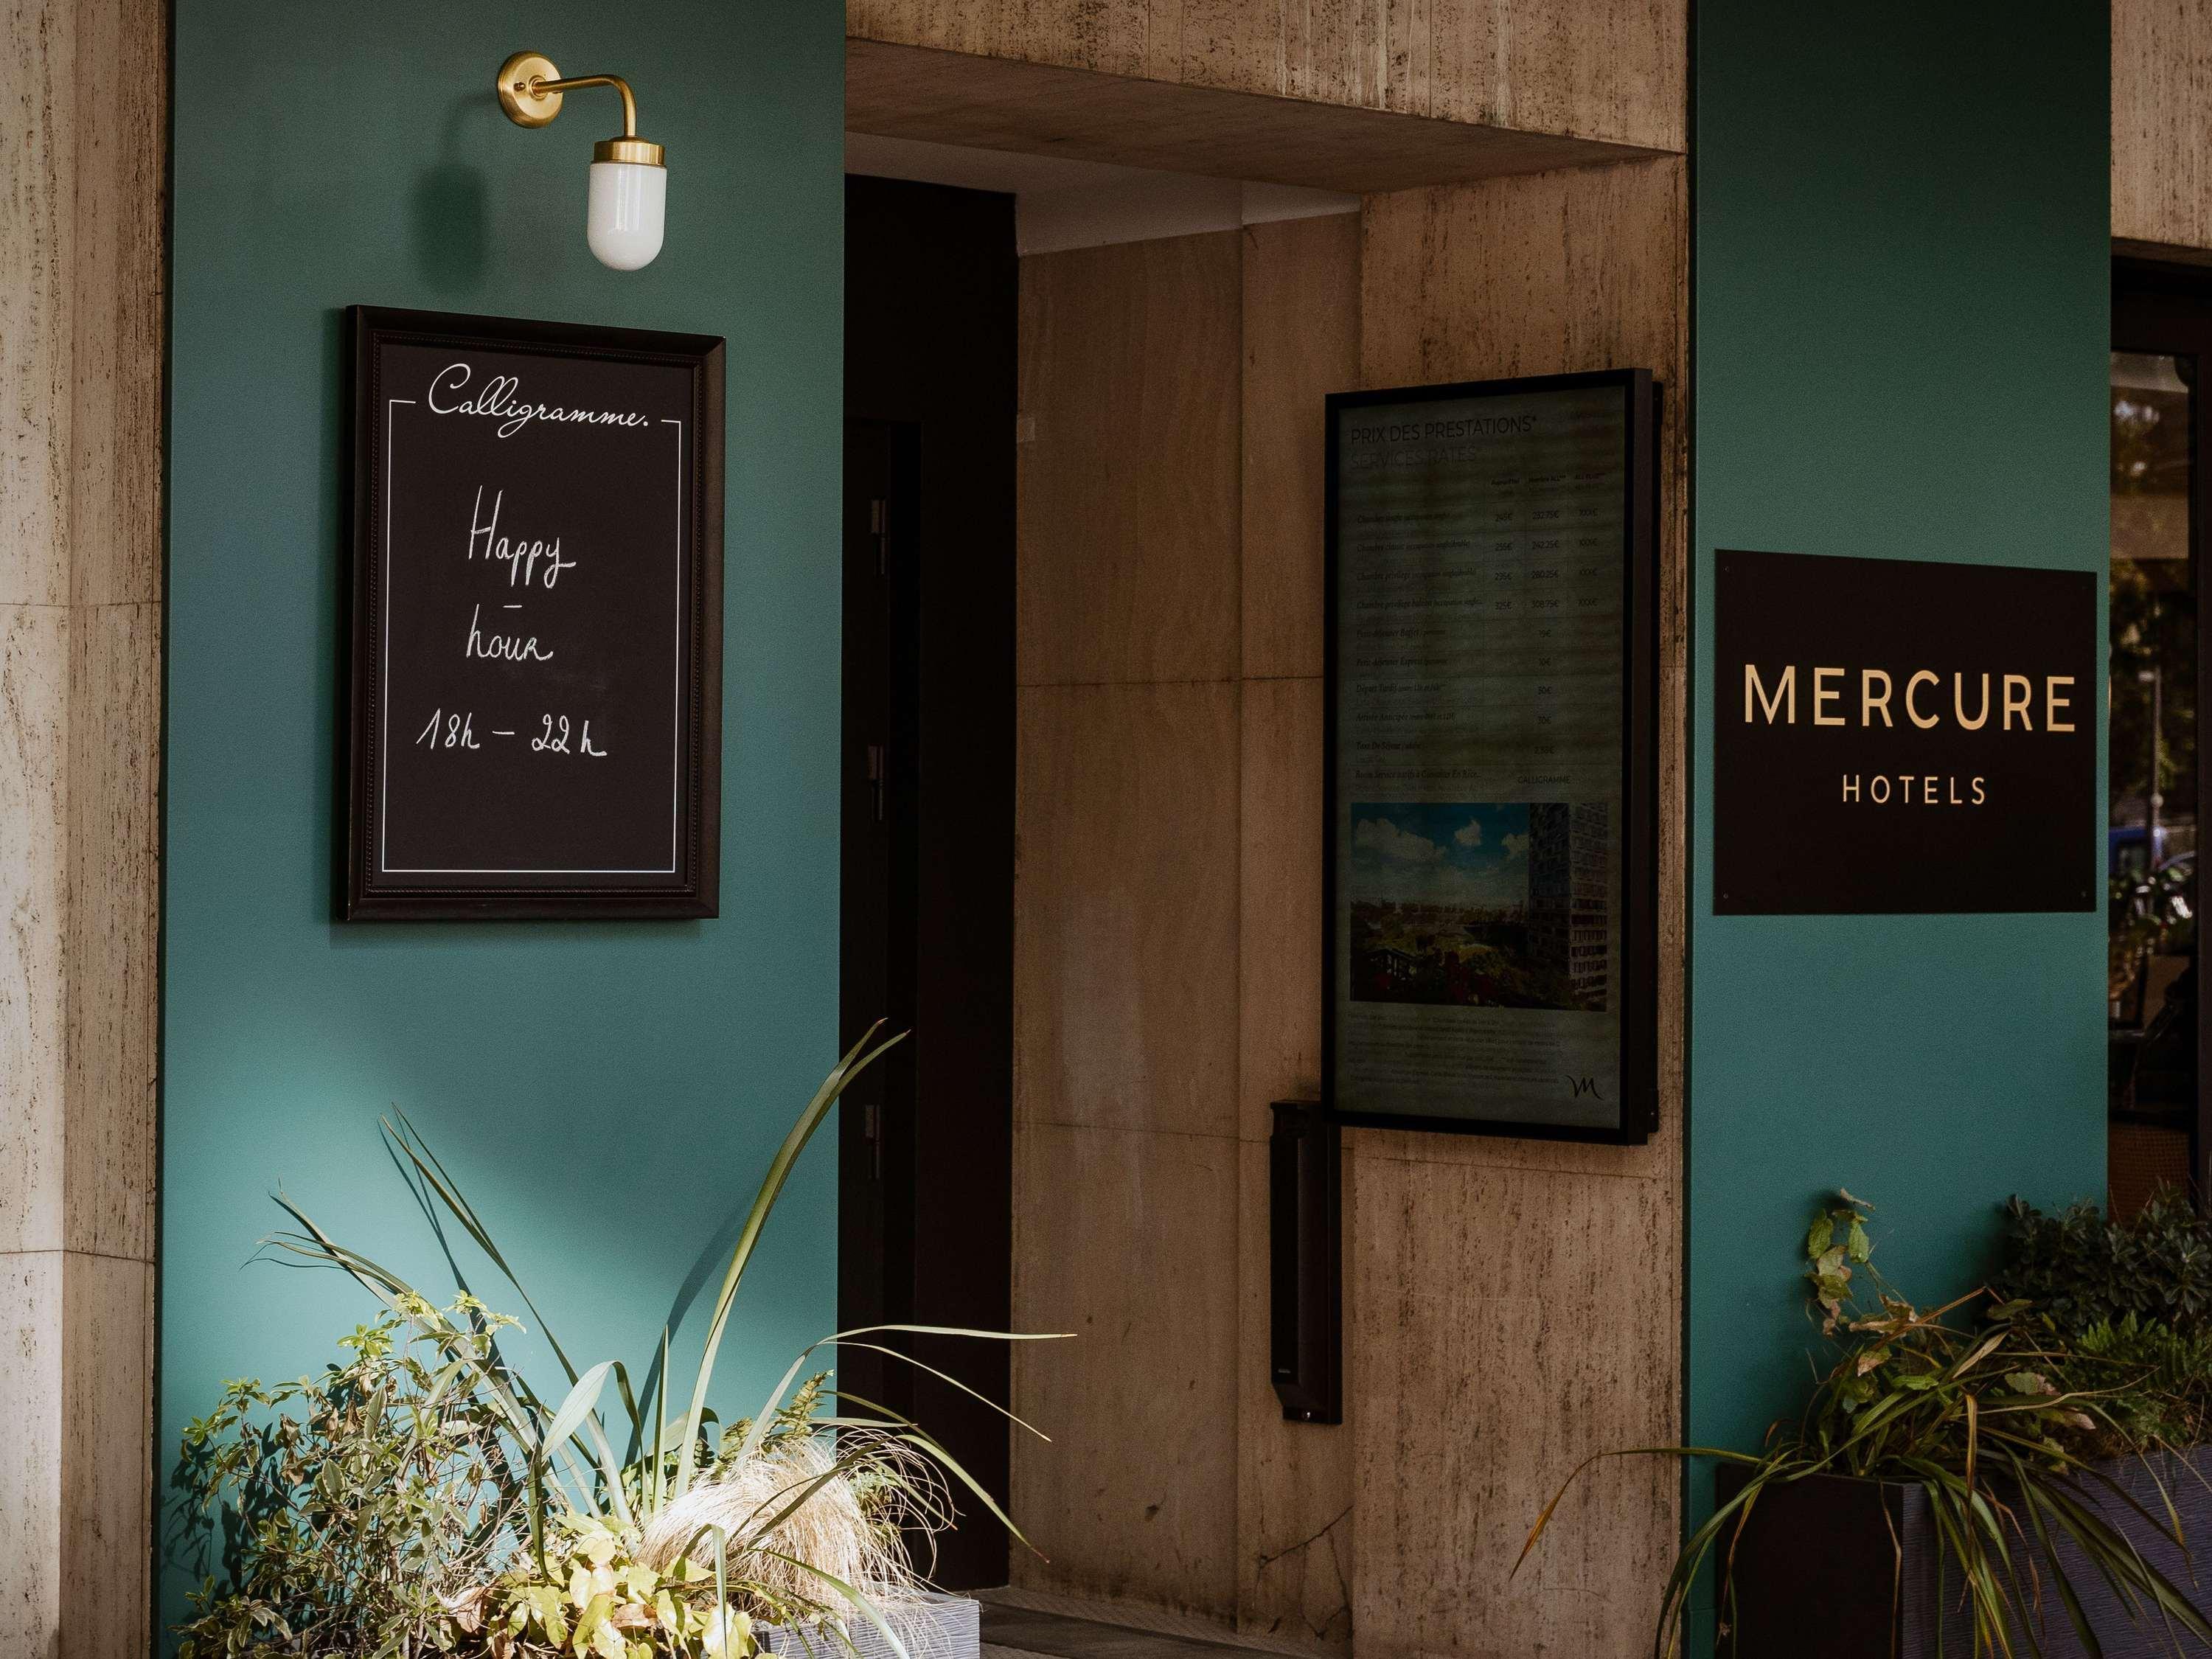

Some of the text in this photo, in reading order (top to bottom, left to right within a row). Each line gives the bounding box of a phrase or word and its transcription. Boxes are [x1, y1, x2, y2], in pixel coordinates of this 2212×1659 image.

[428, 363, 650, 438] Calligramme.
[1351, 426, 1385, 445] PRIX
[1390, 424, 1420, 442] DES
[467, 485, 577, 589] Happy
[466, 603, 554, 662] hour
[1744, 664, 2076, 733] MERCURE
[416, 708, 481, 751] 18h
[1517, 775, 1571, 785] CALLIGRAMME
[1843, 774, 1986, 805] HOTELS
